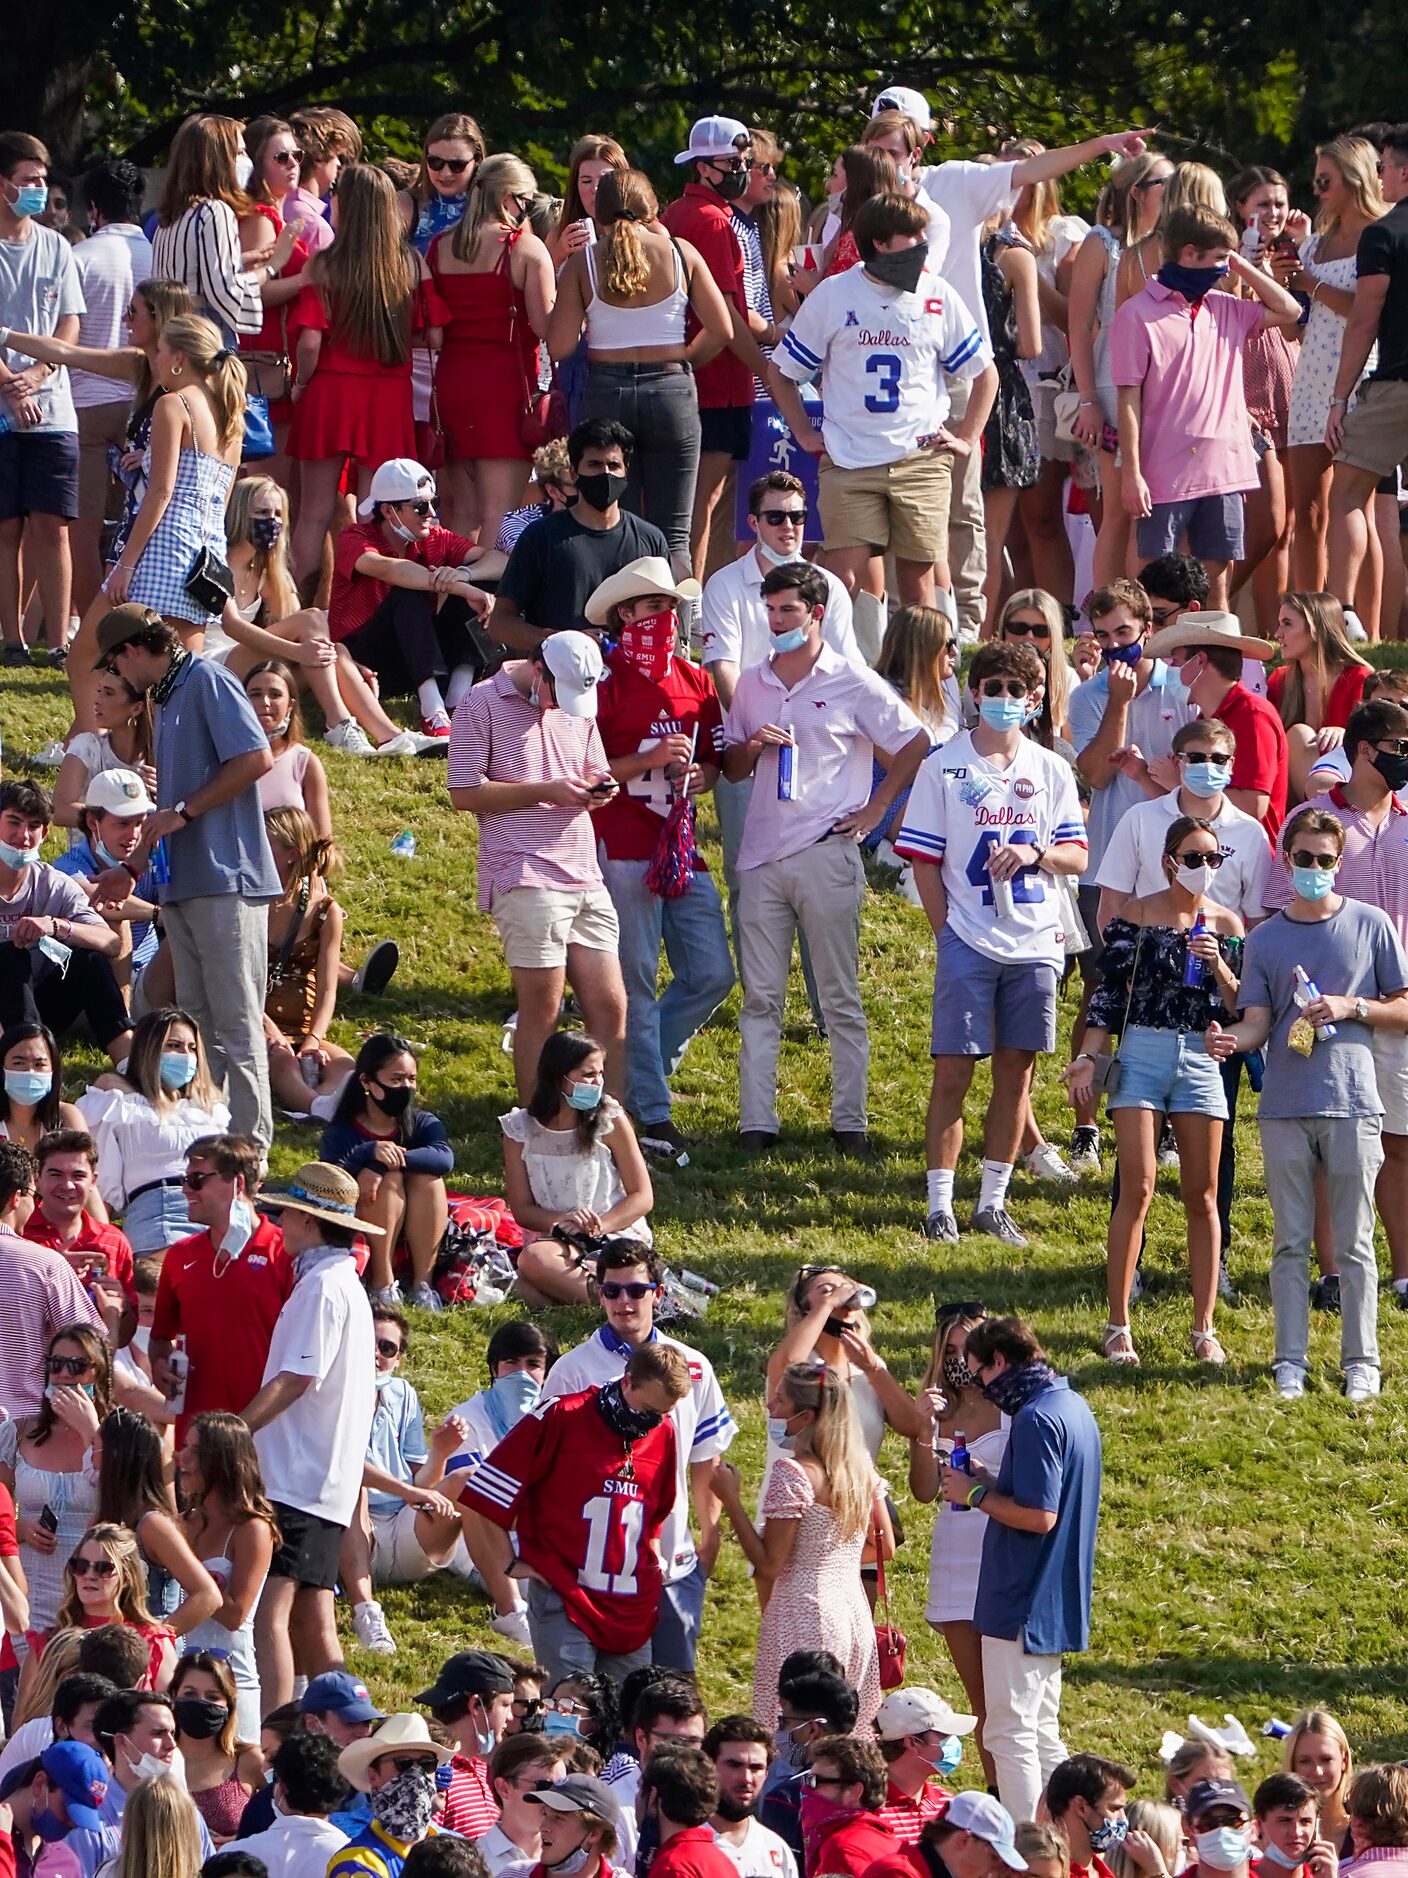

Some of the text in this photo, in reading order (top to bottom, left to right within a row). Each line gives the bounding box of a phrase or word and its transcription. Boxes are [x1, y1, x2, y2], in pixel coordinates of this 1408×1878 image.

[858, 329, 910, 346] Dallas
[864, 354, 901, 413] 3
[636, 653, 655, 662] SMU
[650, 721, 681, 735] SMU
[975, 806, 1036, 825] Dallas
[603, 1479, 639, 1497] SMU
[577, 1496, 645, 1595] 11
